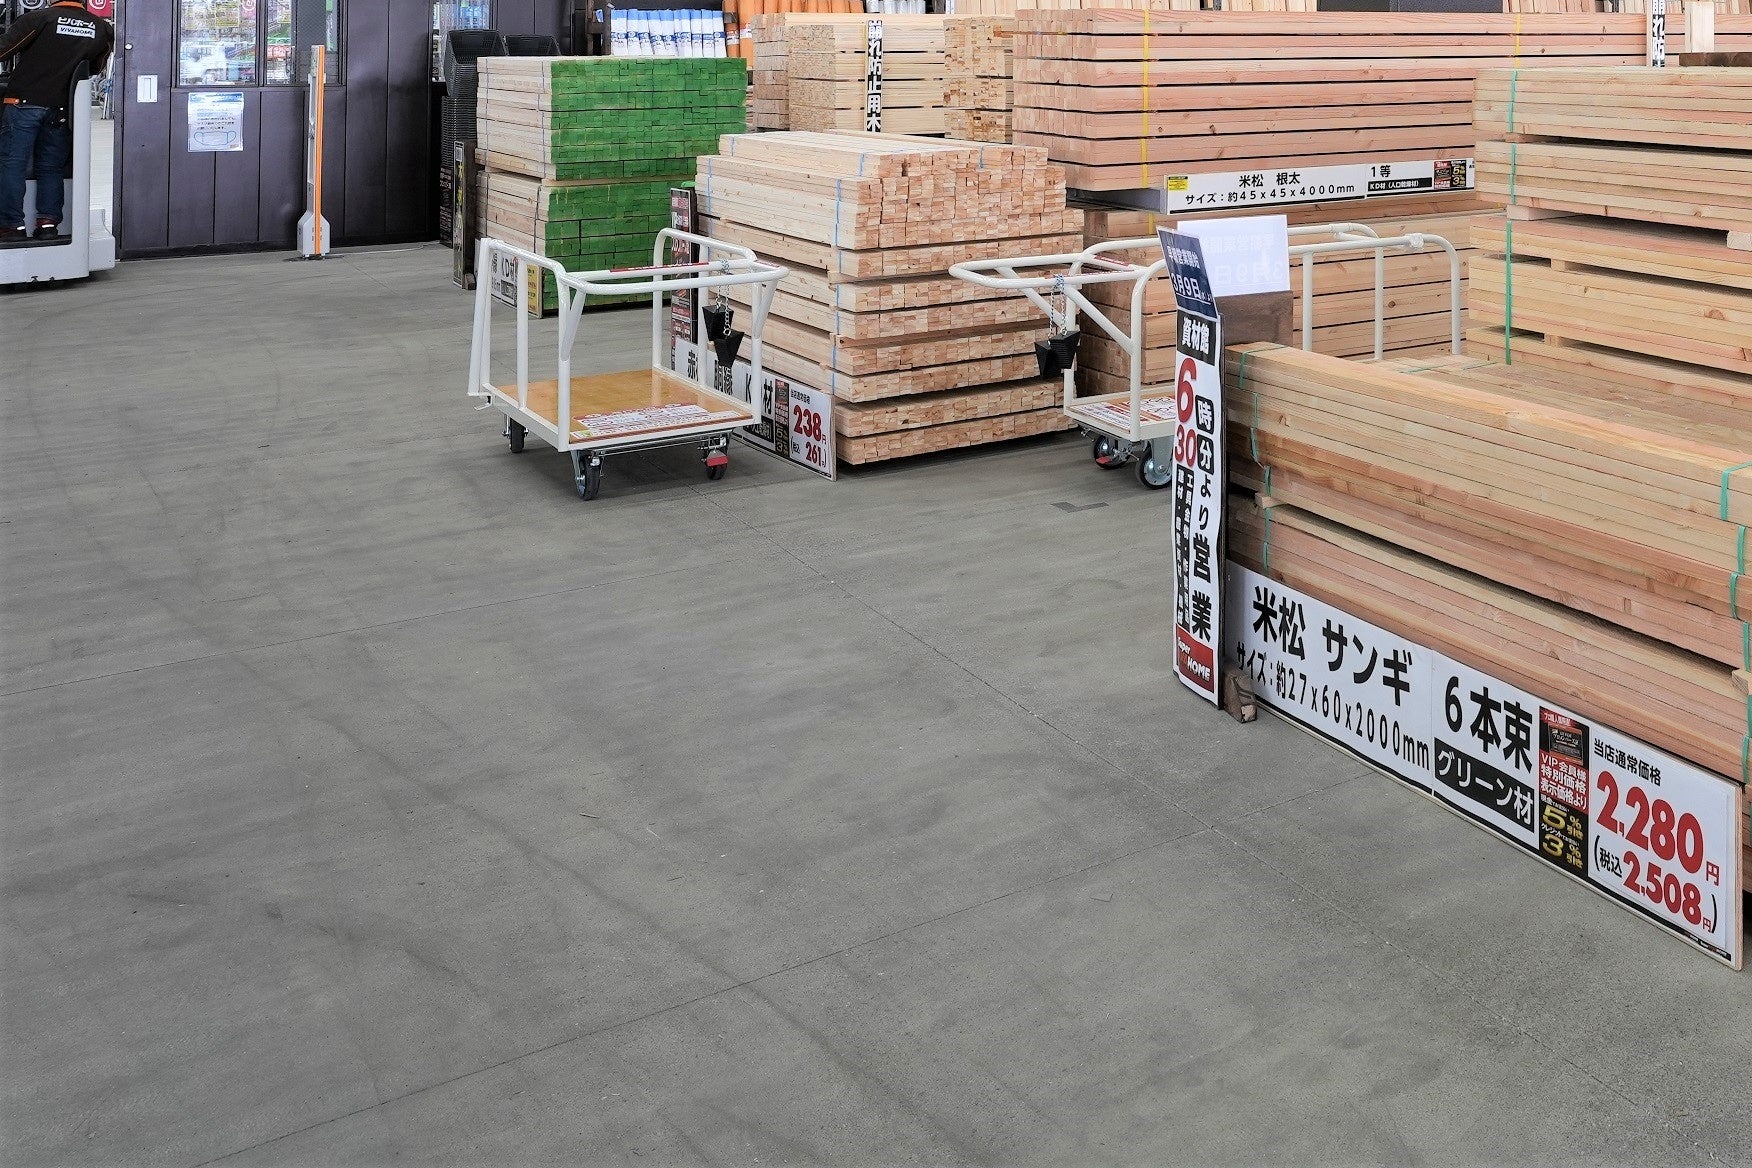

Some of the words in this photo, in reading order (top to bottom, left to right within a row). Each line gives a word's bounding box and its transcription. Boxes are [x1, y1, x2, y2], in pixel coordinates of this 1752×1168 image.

[57, 16, 96, 30] ビバホーム
[60, 25, 95, 37] VIVAHOME
[867, 19, 882, 133] 崩れ防止用木
[1239, 173, 1264, 189] 米松
[1276, 172, 1302, 186] 根太
[1370, 164, 1391, 179] 1等
[1182, 316, 1210, 355] 資材館
[1177, 357, 1197, 423] 6
[1174, 424, 1197, 467] 30
[1191, 473, 1213, 643] より営業
[1253, 585, 1306, 661] 米松
[1322, 618, 1413, 707] サンギ
[1444, 675, 1533, 774] 6本束
[1541, 765, 1587, 795] 特別価格
[1593, 738, 1662, 787] 当店通常価格
[1437, 748, 1534, 825] グリーン材
[1540, 777, 1587, 811] 表示価格より
[1543, 804, 1568, 831] 5
[1542, 832, 1565, 858] 3
